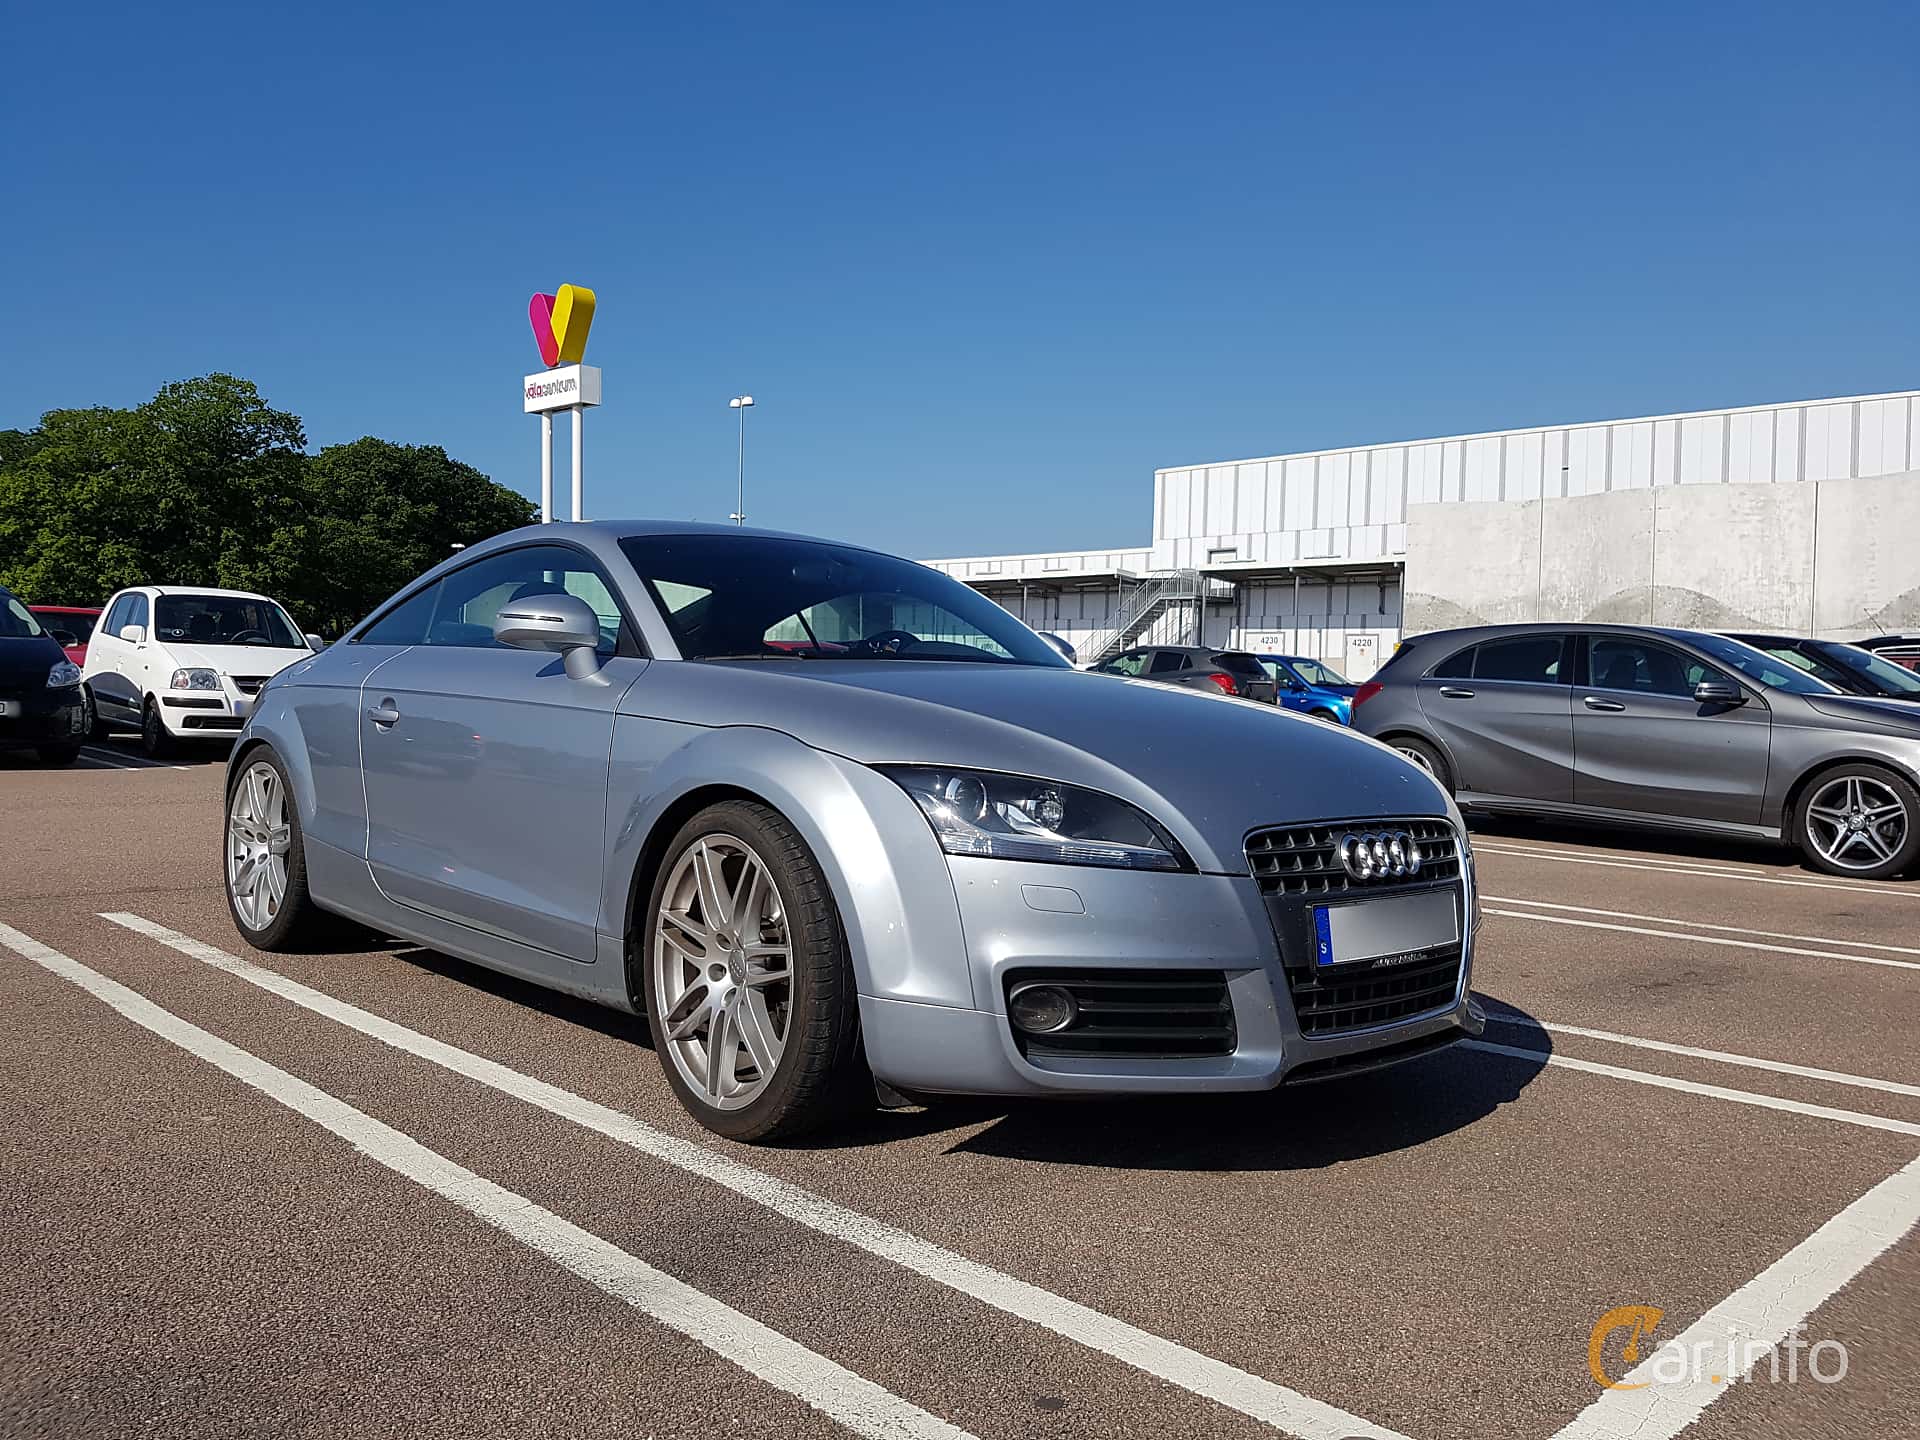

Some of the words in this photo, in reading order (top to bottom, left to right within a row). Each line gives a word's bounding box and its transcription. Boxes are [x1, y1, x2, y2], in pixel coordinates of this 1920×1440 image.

[1260, 636, 1279, 645] 4230
[1351, 639, 1373, 648] 4220
[1320, 942, 1328, 954] S
